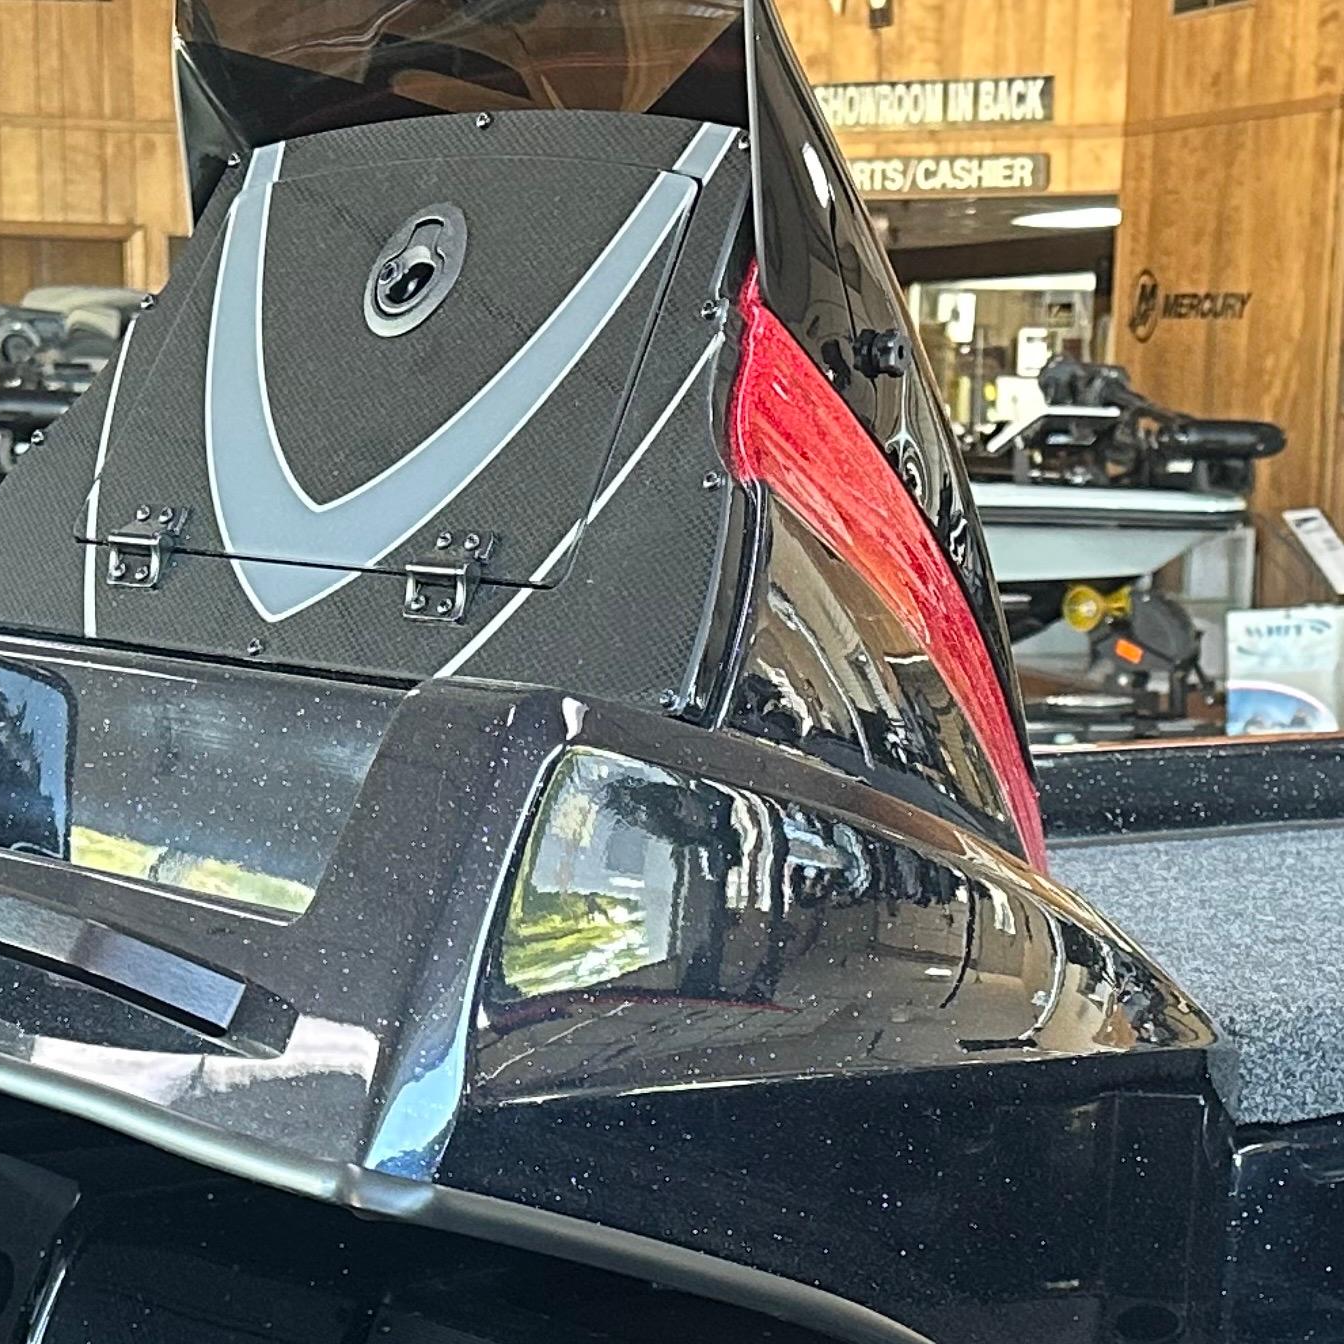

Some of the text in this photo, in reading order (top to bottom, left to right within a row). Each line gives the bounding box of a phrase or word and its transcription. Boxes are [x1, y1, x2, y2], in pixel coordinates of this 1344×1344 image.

[947, 82, 975, 122] IN
[977, 79, 1044, 121] BACK
[849, 157, 1034, 192] RTS/CASHIER
[1160, 291, 1253, 320] MERCURY
